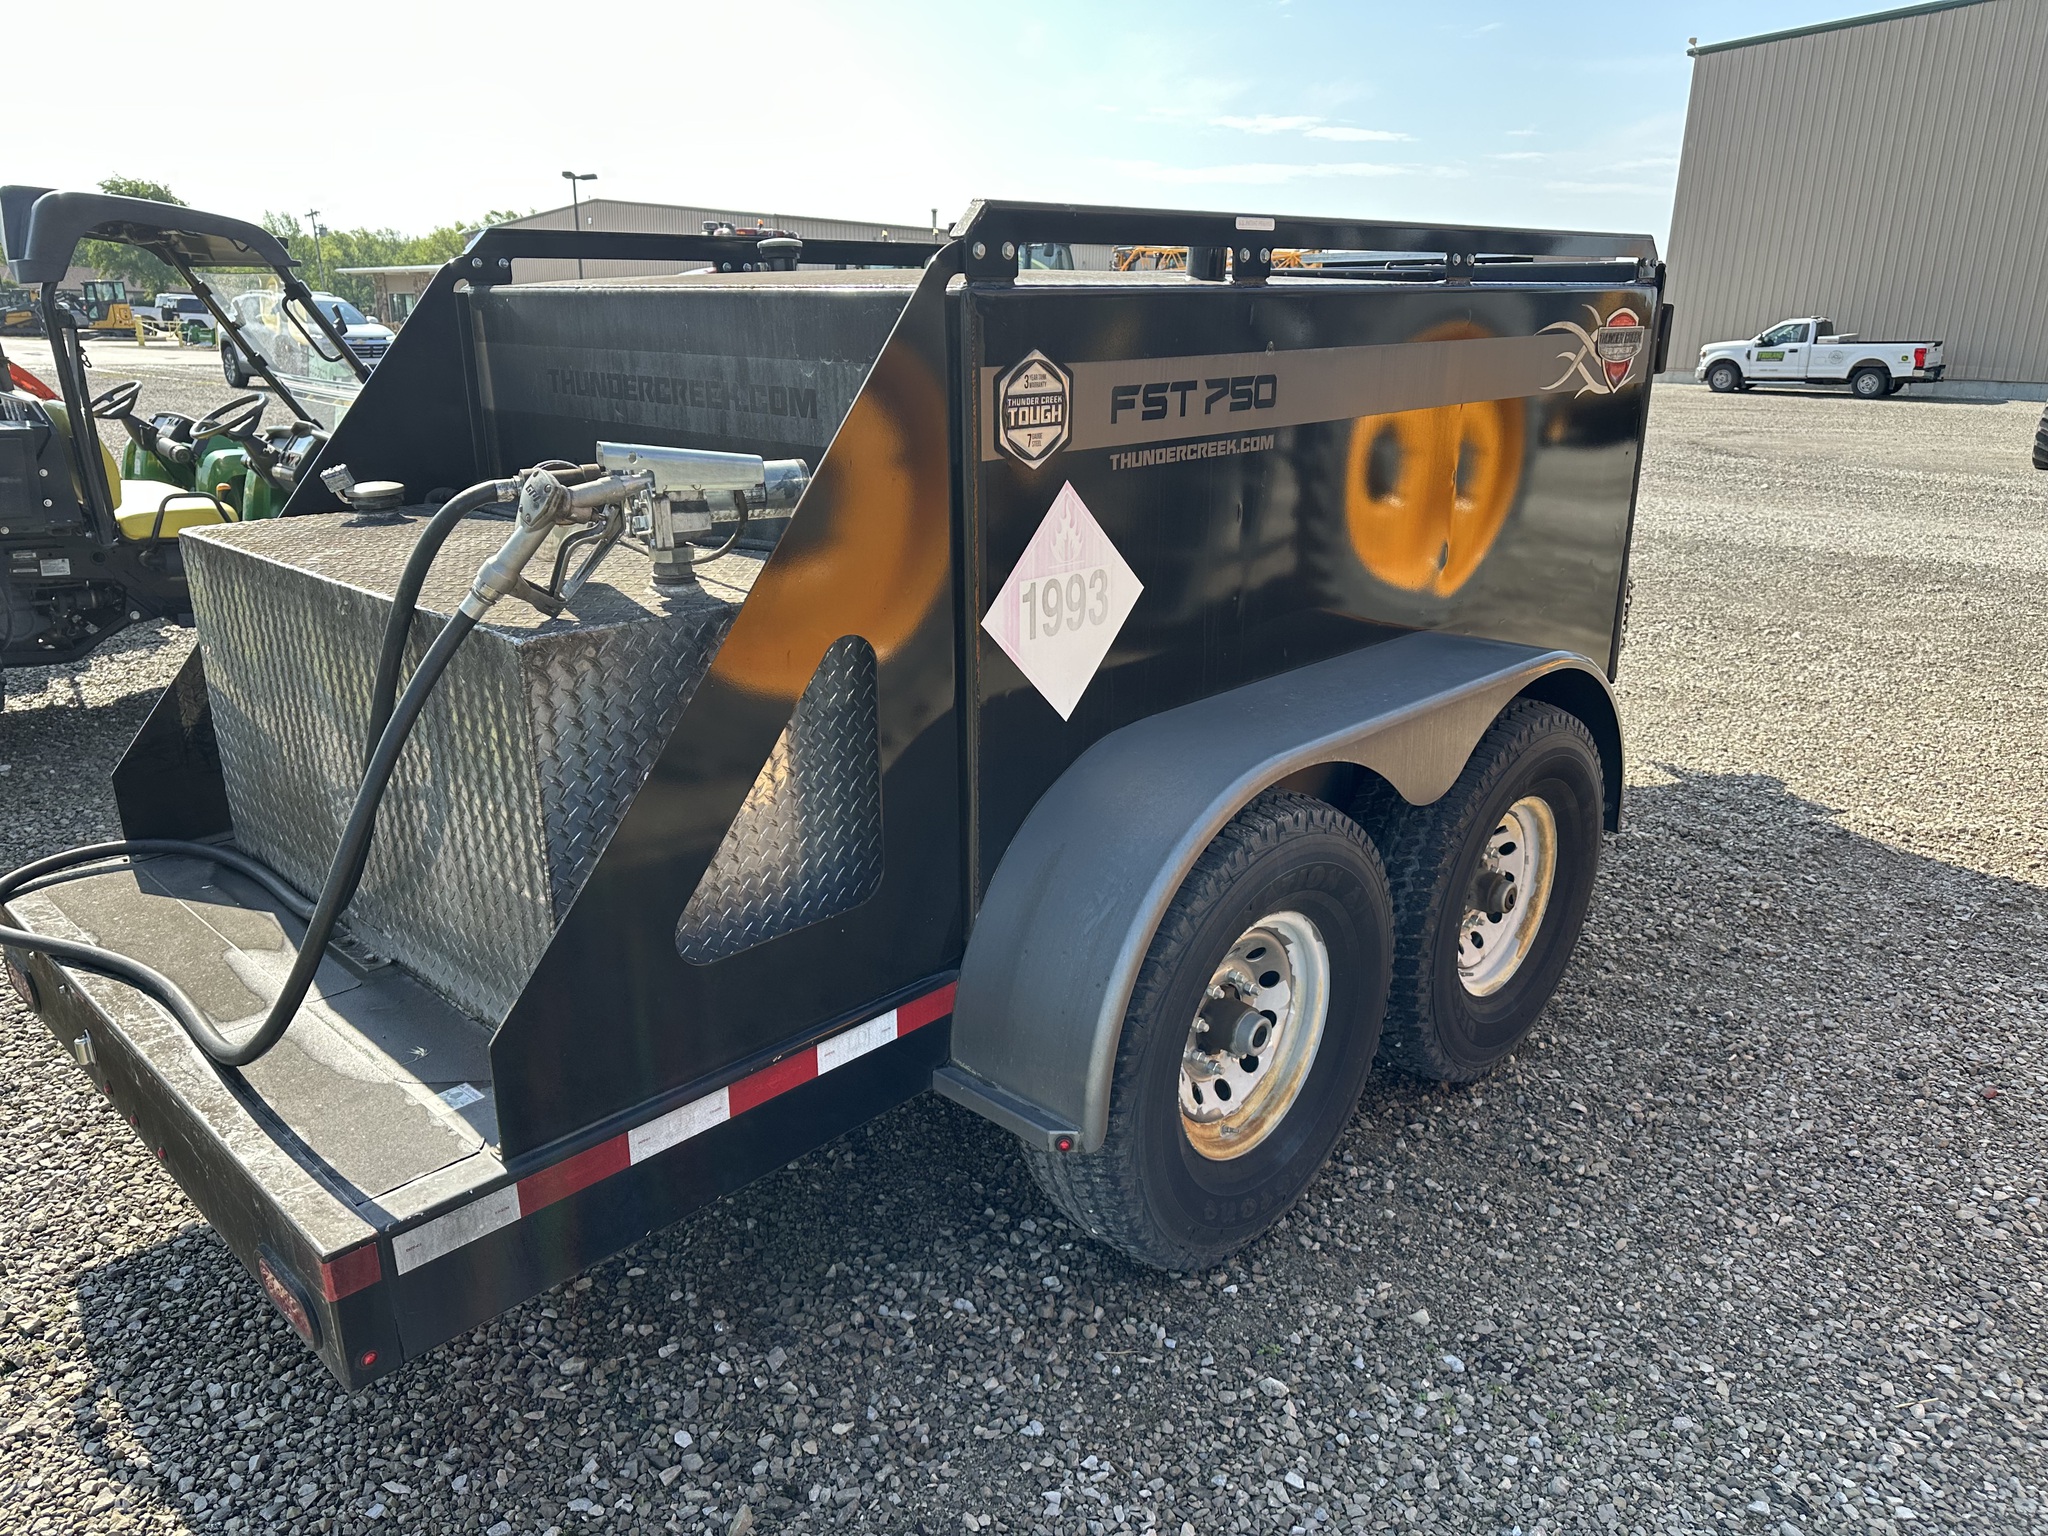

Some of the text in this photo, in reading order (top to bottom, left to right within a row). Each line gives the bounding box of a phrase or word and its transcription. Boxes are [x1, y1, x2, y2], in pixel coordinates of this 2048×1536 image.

[1024, 374, 1030, 389] 3
[1008, 395, 1062, 406] THUNDER CREEK
[1111, 374, 1278, 424] FST 750
[1007, 404, 1062, 427] TOUGH
[1027, 433, 1032, 448] 7
[1109, 434, 1275, 471] THUNDERCREEK.COM
[1022, 568, 1109, 641] 1993
